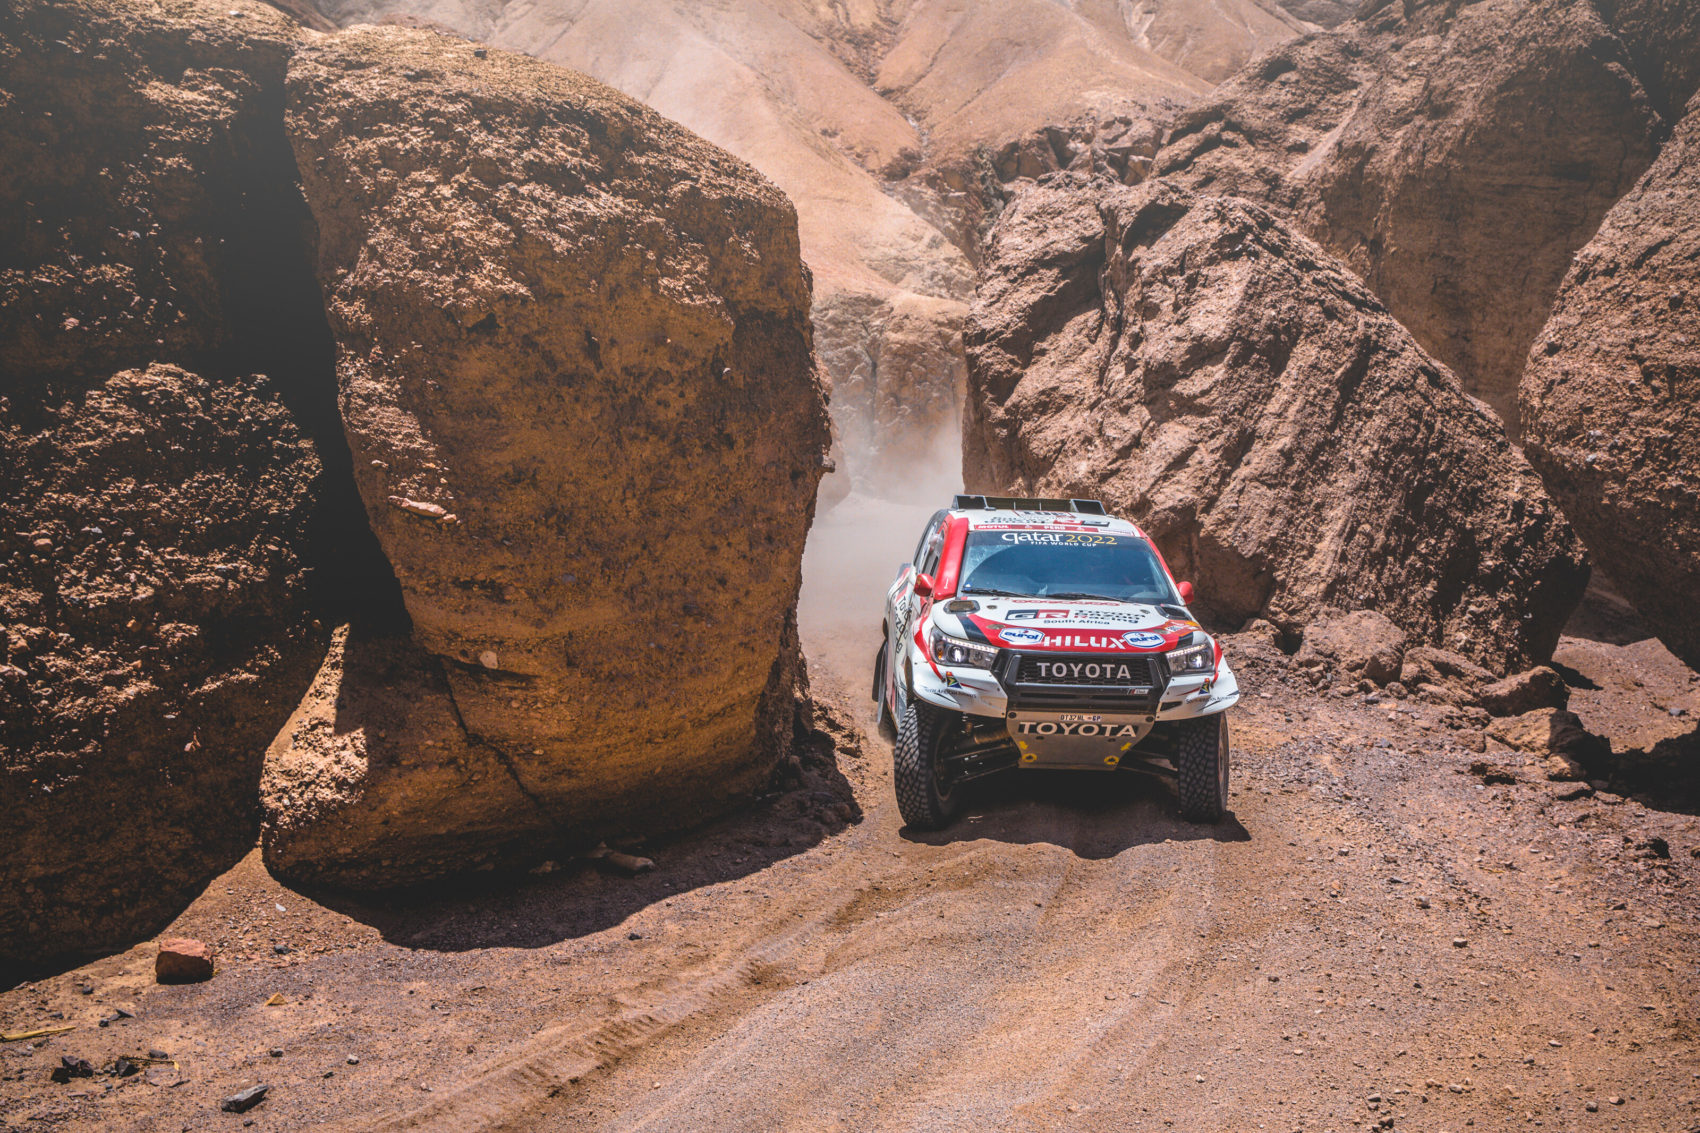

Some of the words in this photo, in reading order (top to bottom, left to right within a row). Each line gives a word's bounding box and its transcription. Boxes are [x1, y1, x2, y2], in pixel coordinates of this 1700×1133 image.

[1001, 532, 1064, 544] qatar
[1065, 534, 1118, 545] 2022
[1004, 631, 1039, 641] eurol
[1043, 635, 1126, 650] HILUX
[1129, 634, 1161, 643] eurol
[1036, 662, 1131, 679] TOYOTA
[1019, 721, 1137, 738] TOYOTA
